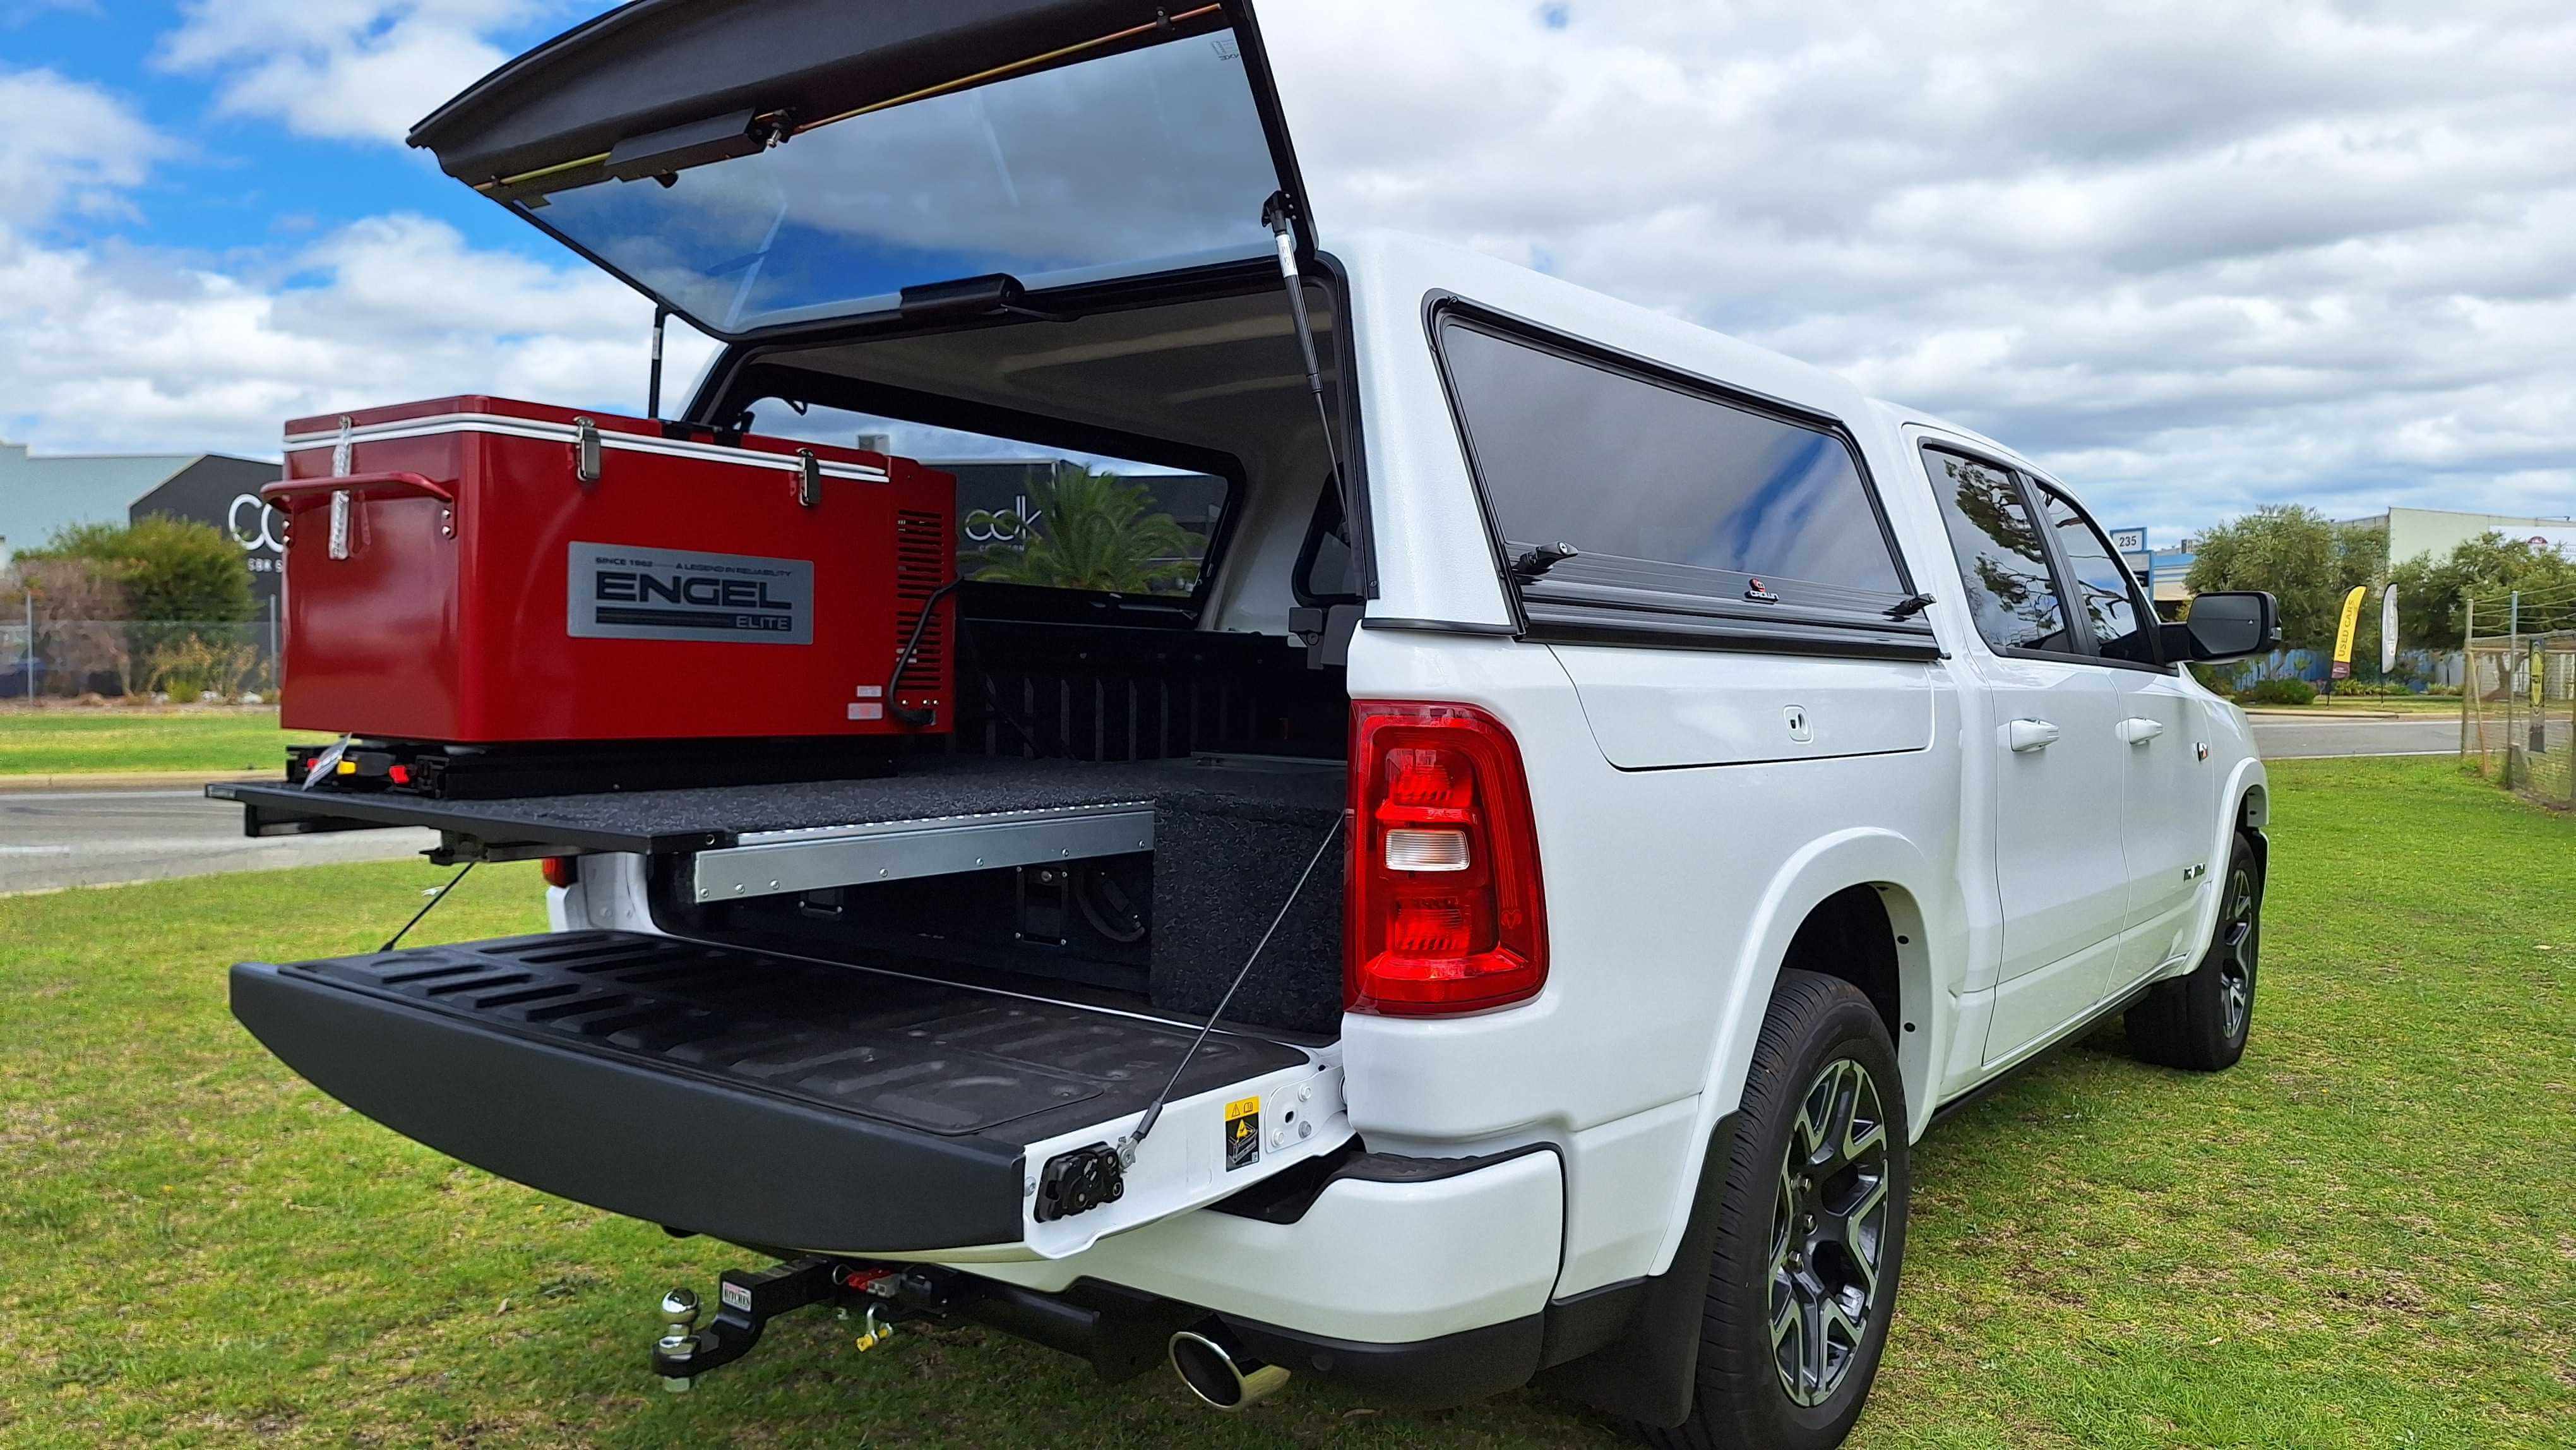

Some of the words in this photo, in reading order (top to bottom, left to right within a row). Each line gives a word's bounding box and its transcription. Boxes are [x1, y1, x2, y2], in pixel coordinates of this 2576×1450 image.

[2119, 535, 2137, 547] 235
[595, 556, 626, 566] SINCE
[596, 571, 792, 610] ENGEL
[736, 615, 789, 630] ELITE
[2338, 630, 2349, 657] USED
[2344, 599, 2355, 628] CARS
